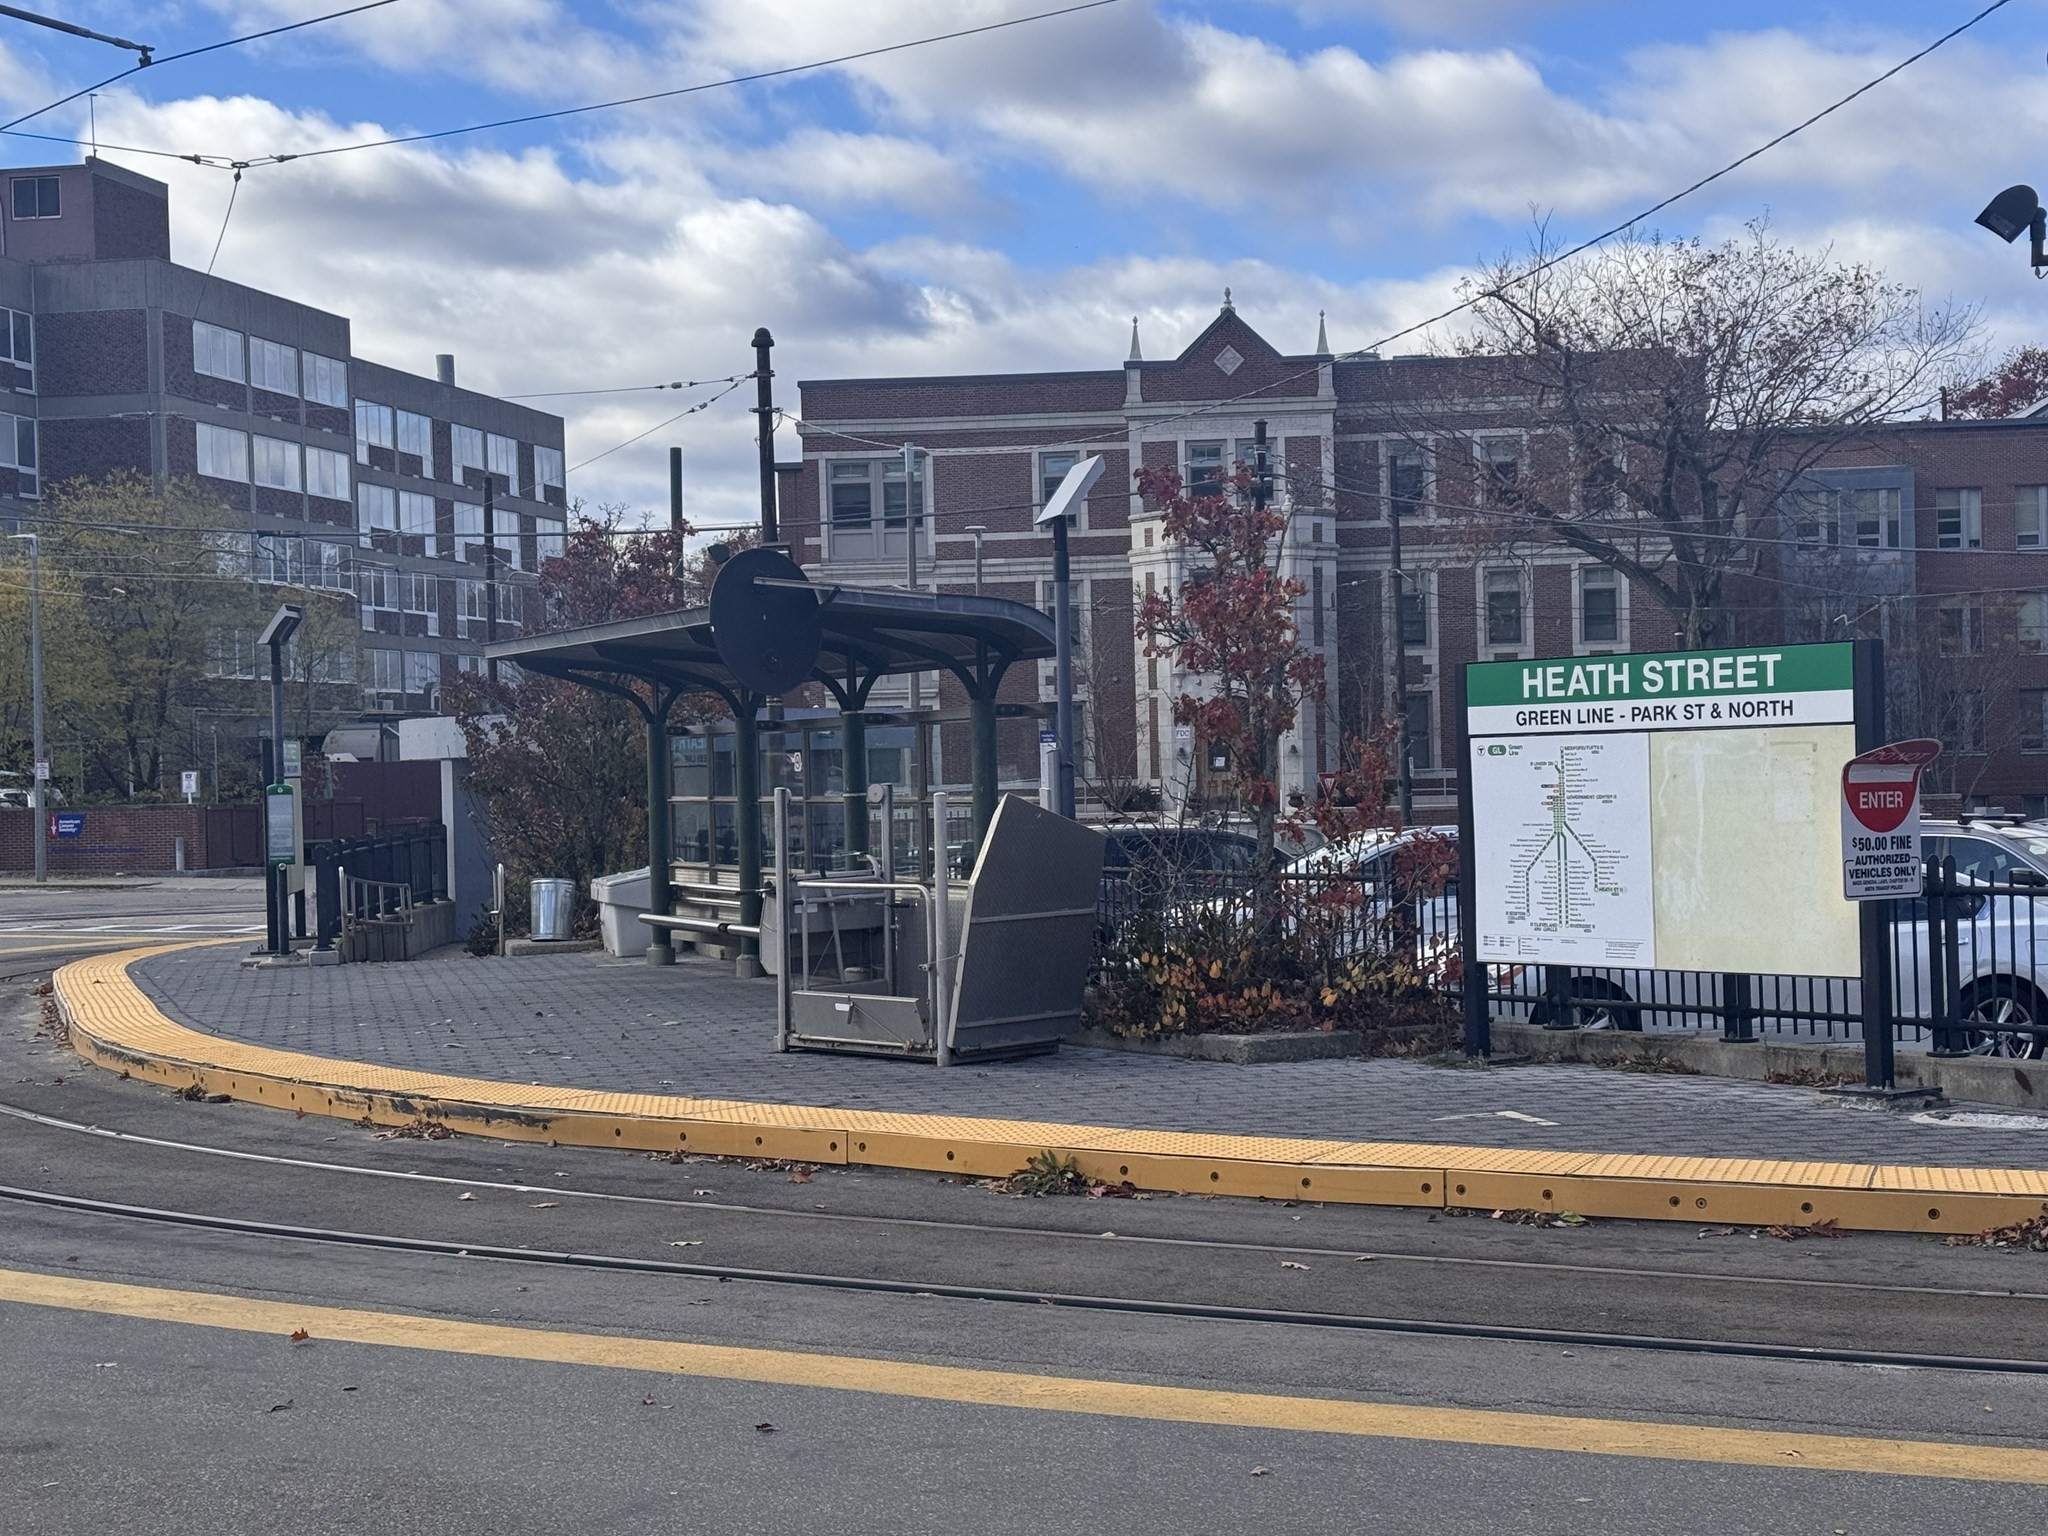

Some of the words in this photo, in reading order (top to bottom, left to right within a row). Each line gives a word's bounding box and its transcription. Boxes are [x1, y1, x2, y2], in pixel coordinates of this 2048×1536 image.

[1522, 662, 1630, 699] HEATH
[1642, 653, 1782, 693] STREET
[1516, 709, 1571, 726] GREEN
[1577, 707, 1614, 724] LINE
[1631, 704, 1678, 722] PARK
[1683, 703, 1705, 720] ST
[1710, 703, 1722, 719] &
[1728, 700, 1794, 719] NORTH
[1492, 746, 1503, 755] GL
[1859, 790, 1904, 809] ENTER
[1852, 836, 1888, 852] $50.00
[1890, 835, 1912, 850] FINE
[1855, 853, 1911, 866] AUTHORIZED
[1848, 867, 1892, 879] VEHICLES
[1893, 865, 1917, 877] ONLY
